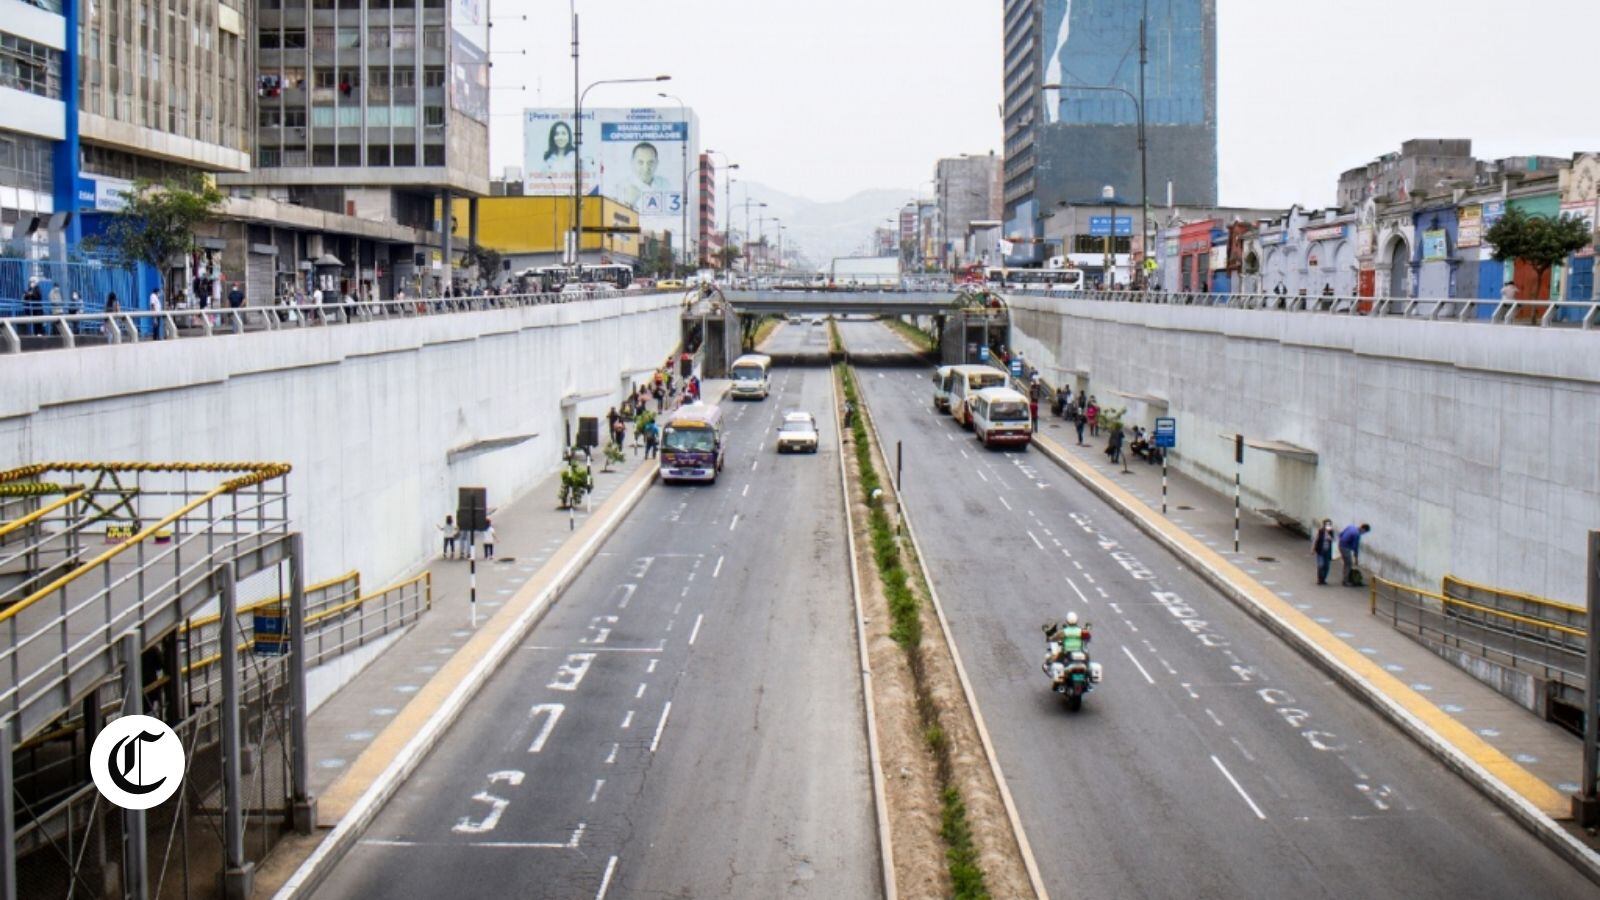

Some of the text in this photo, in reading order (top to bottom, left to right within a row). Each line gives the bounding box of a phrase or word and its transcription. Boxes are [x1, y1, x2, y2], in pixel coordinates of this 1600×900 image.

[609, 132, 681, 140] OPORTUNIDADES
[648, 195, 680, 210] A 3
